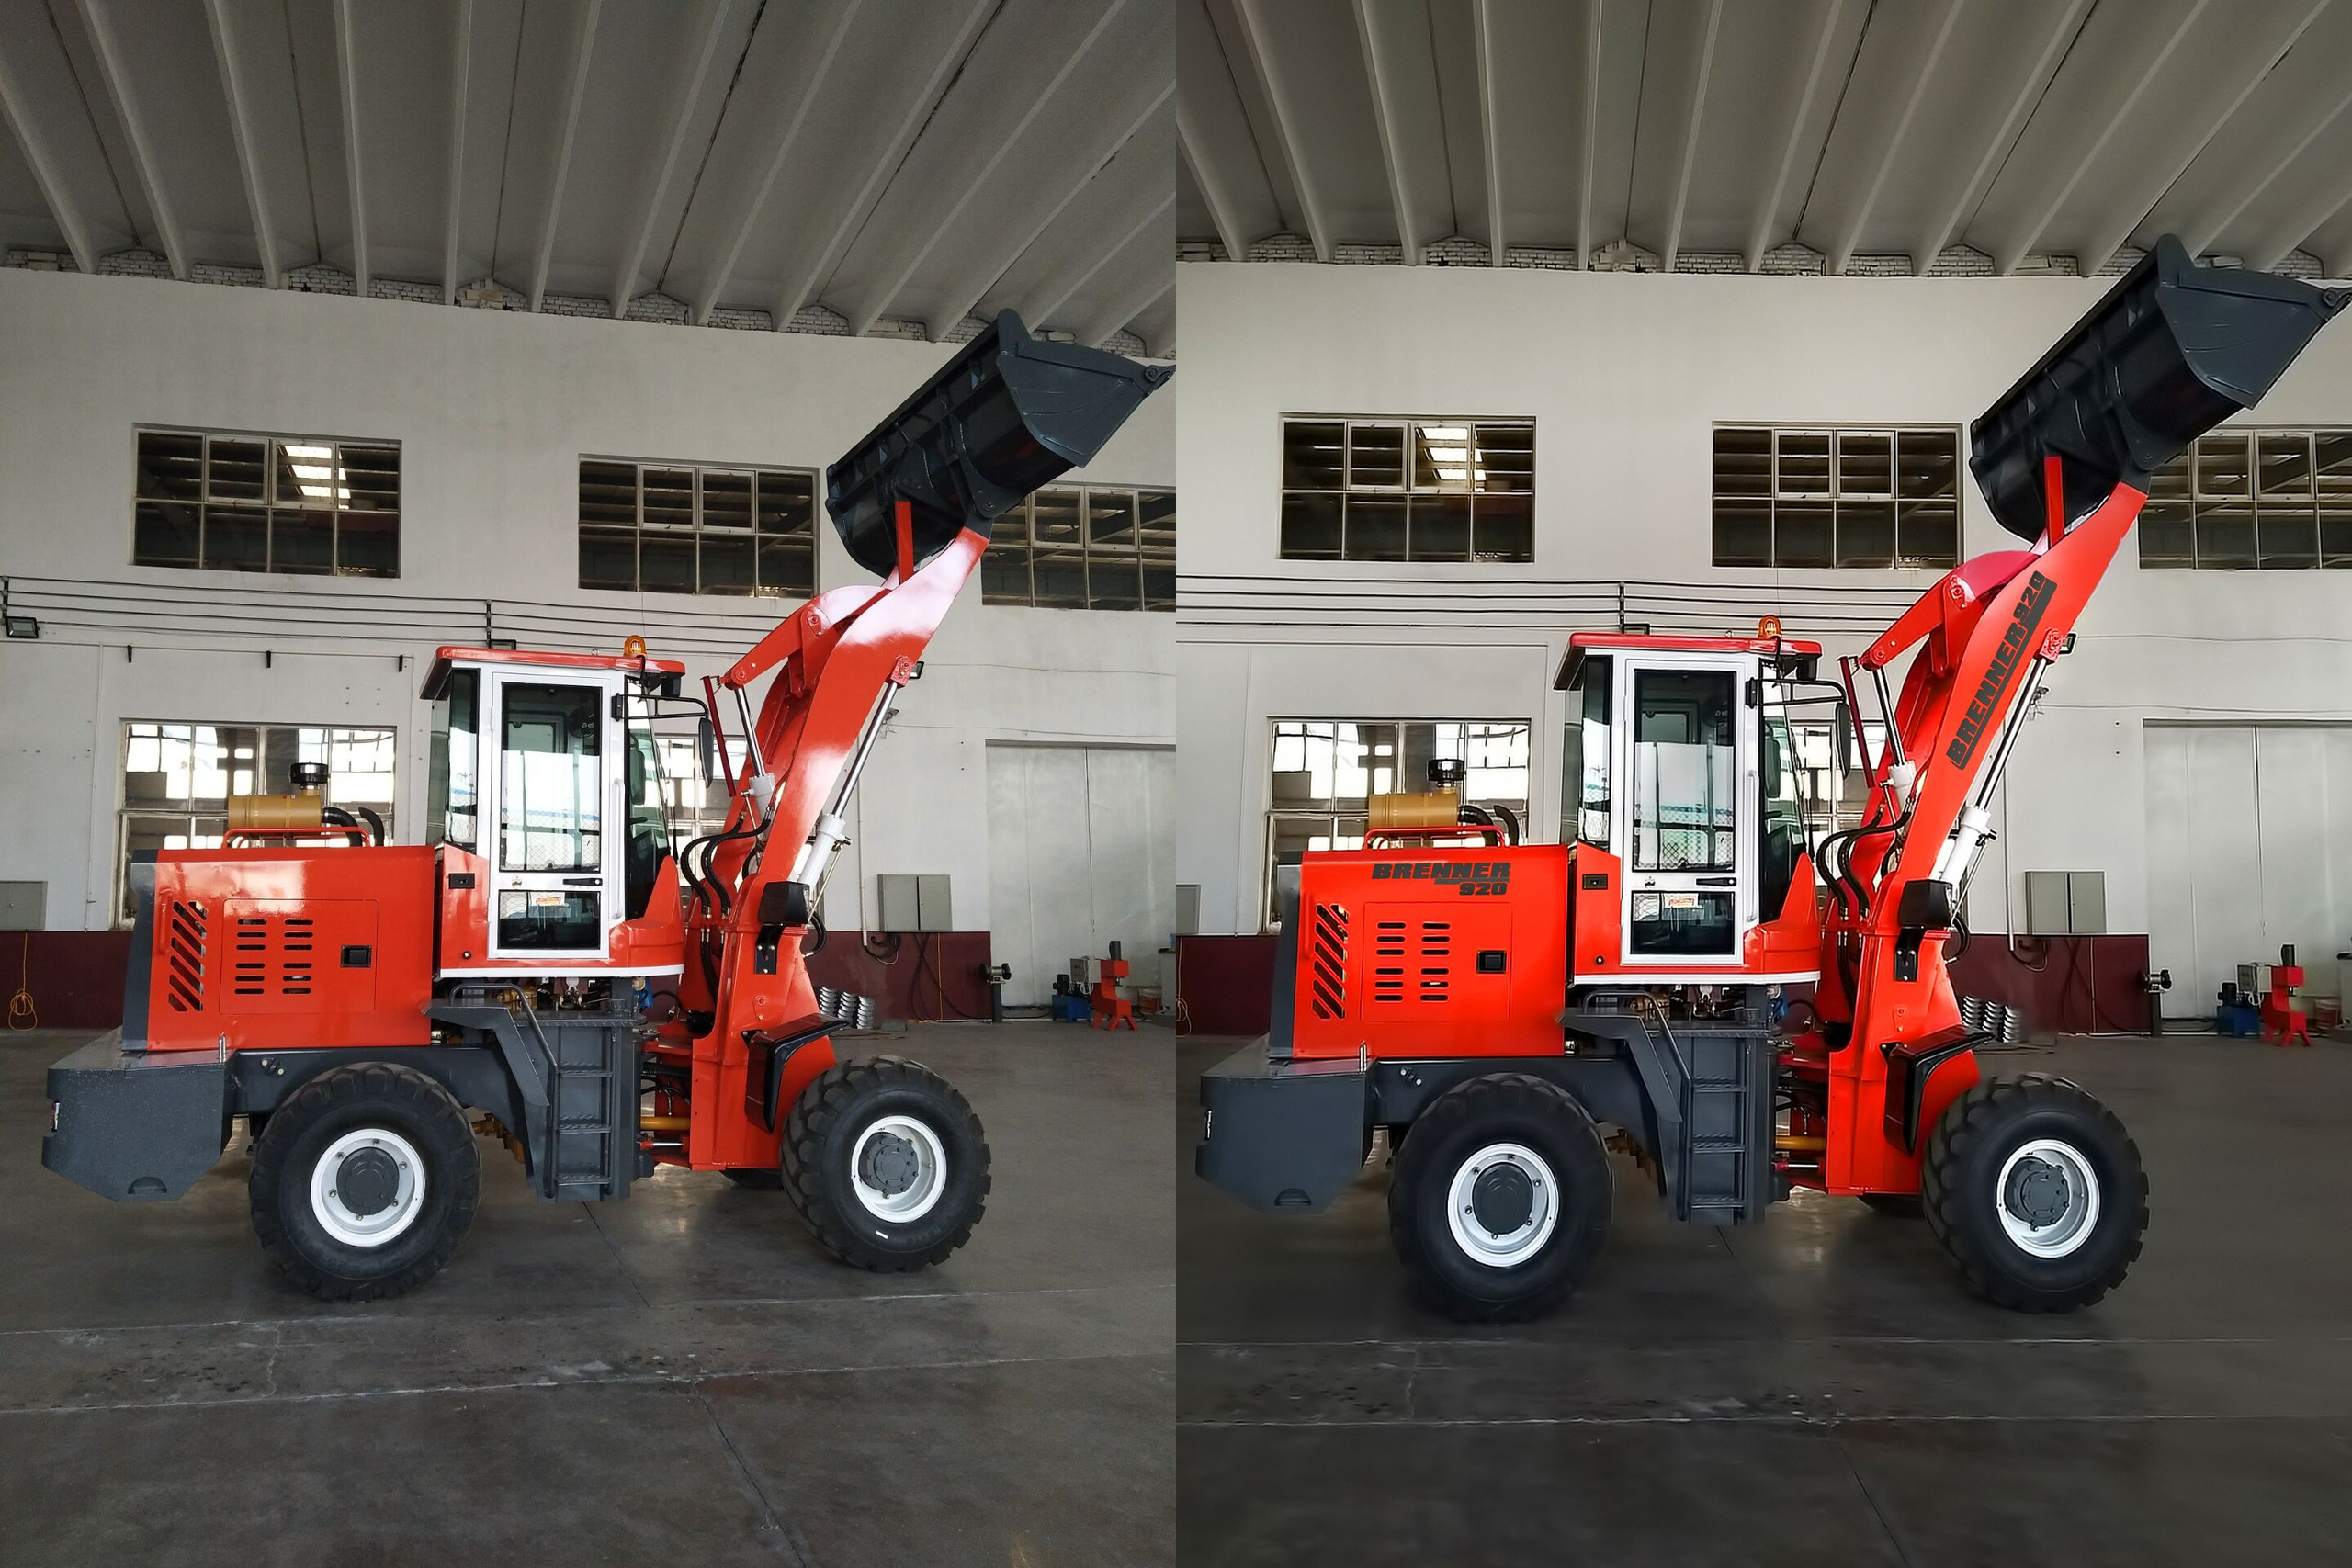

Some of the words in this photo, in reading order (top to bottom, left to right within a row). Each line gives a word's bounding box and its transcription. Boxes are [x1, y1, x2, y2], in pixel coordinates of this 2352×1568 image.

[1946, 622, 2027, 764] BRENNER
[2013, 570, 2046, 622] 920
[1372, 863, 1511, 879] BRENNER
[1459, 883, 1508, 896] 920
